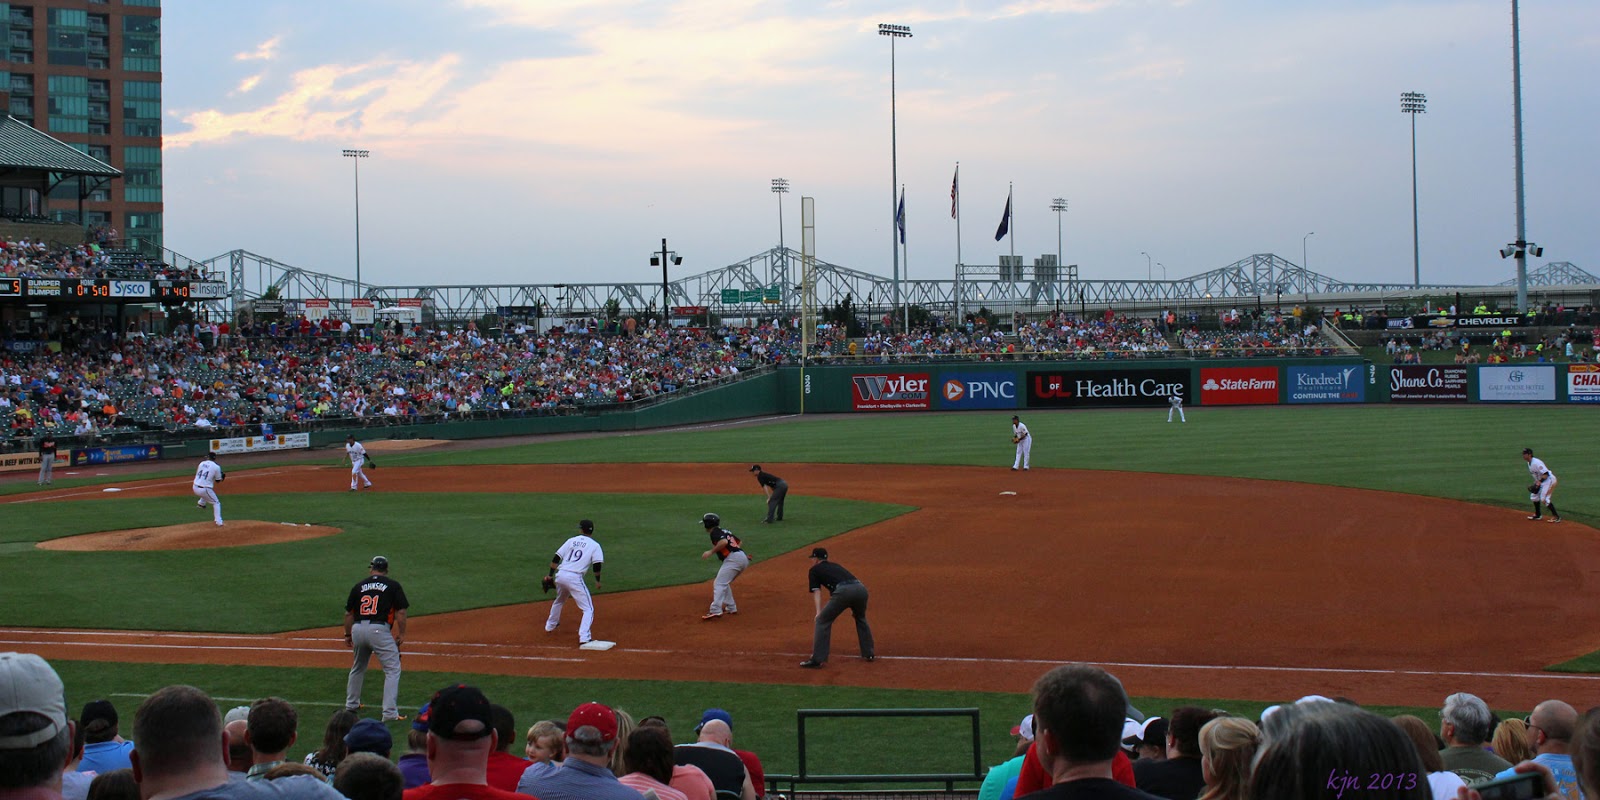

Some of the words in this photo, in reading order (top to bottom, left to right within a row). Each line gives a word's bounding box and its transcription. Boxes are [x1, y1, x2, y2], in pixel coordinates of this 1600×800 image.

[13, 281, 19, 292] 5
[77, 285, 83, 296] 0
[92, 285, 98, 296] 5
[102, 285, 108, 296] 0
[115, 280, 144, 296] Sysco
[162, 287, 166, 296] 1
[174, 287, 179, 296] 4
[182, 286, 188, 297] 0
[200, 283, 226, 297] Insight
[1458, 317, 1518, 325] CHEVROLET
[1297, 373, 1342, 386] Kindred
[1391, 369, 1427, 391] Shane
[1427, 368, 1443, 388] Co.
[1573, 375, 1600, 385] CHA
[853, 376, 927, 400] Wyler
[967, 381, 1014, 398] PNC
[1076, 378, 1137, 397] Health
[1140, 379, 1184, 396] Care
[198, 470, 209, 480] 44
[566, 549, 583, 562] 19
[361, 582, 388, 592] JOHNSON
[360, 595, 379, 615] 21
